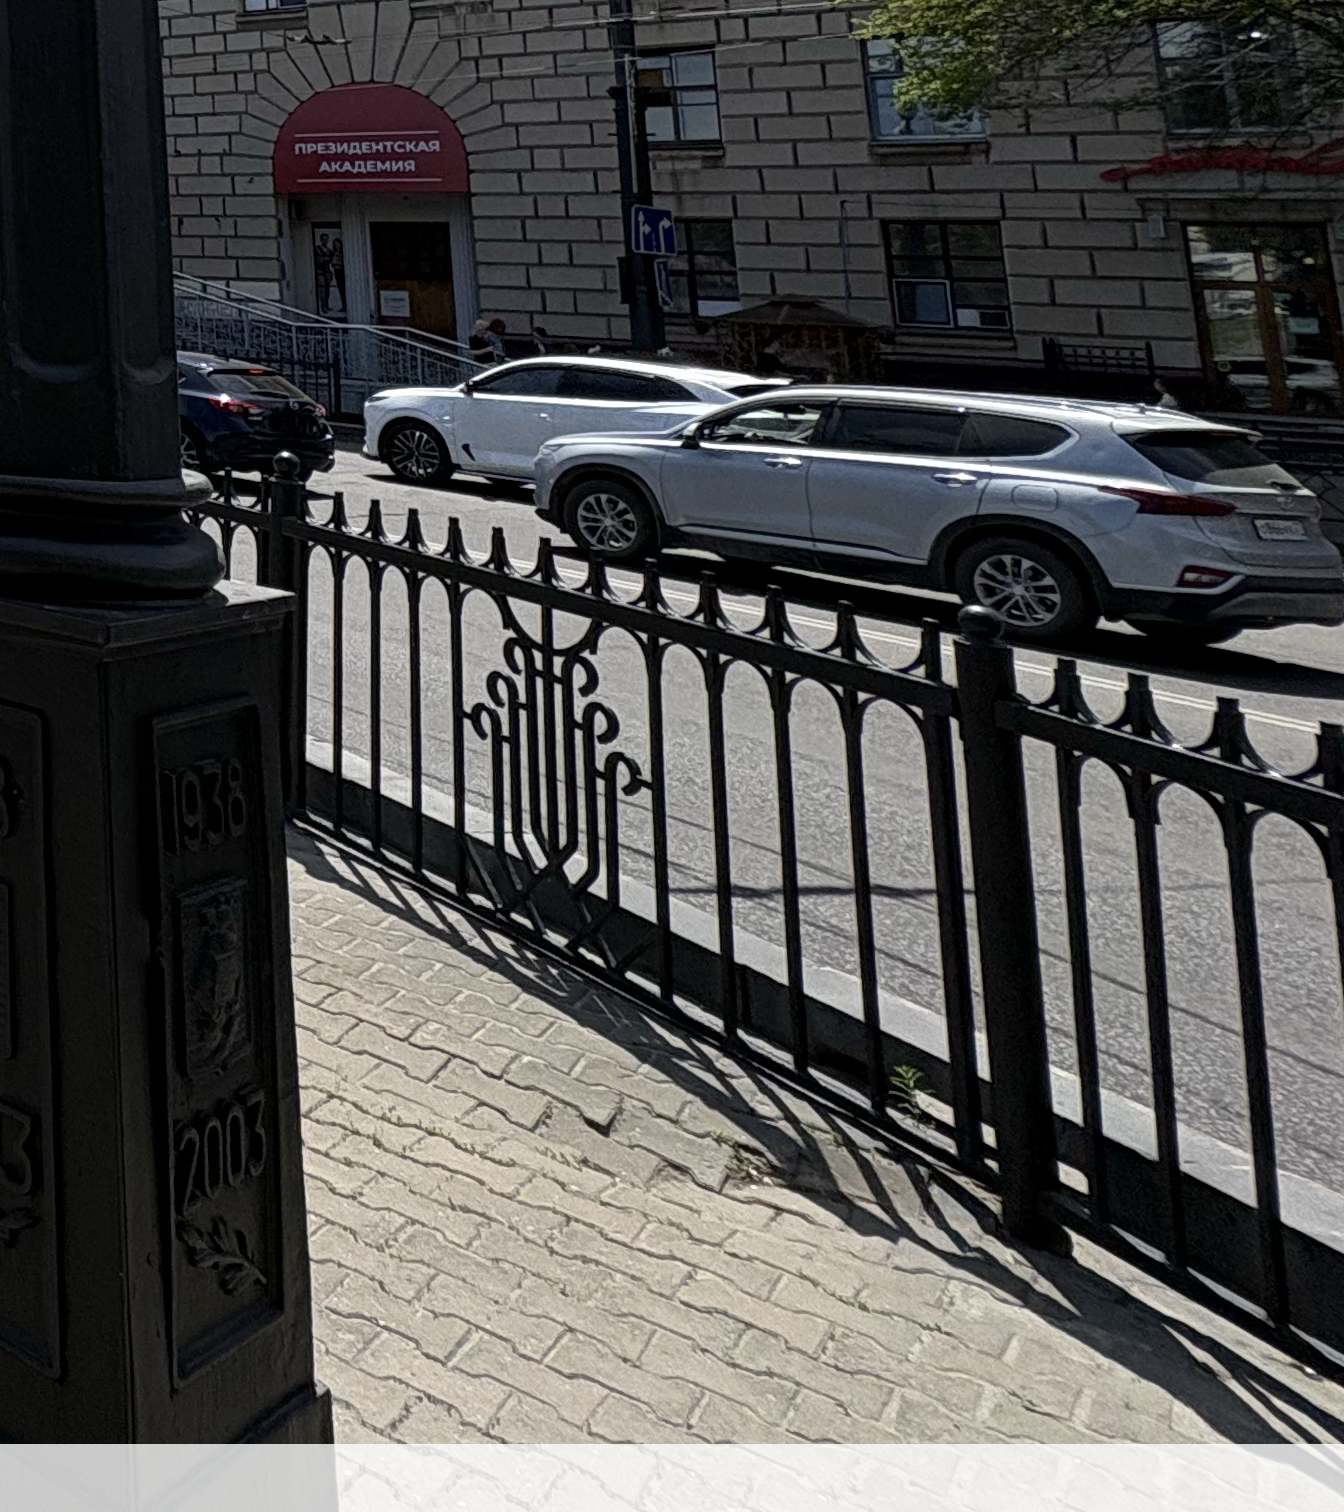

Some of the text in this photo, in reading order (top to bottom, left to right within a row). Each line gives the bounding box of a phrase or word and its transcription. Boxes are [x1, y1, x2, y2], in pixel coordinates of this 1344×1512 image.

[294, 140, 440, 155] ПРЕЗИДЕНТСКАЯ
[319, 160, 416, 174] АКАДЕМИЯ
[162, 756, 248, 855] 1938
[173, 1089, 268, 1218] 2003
